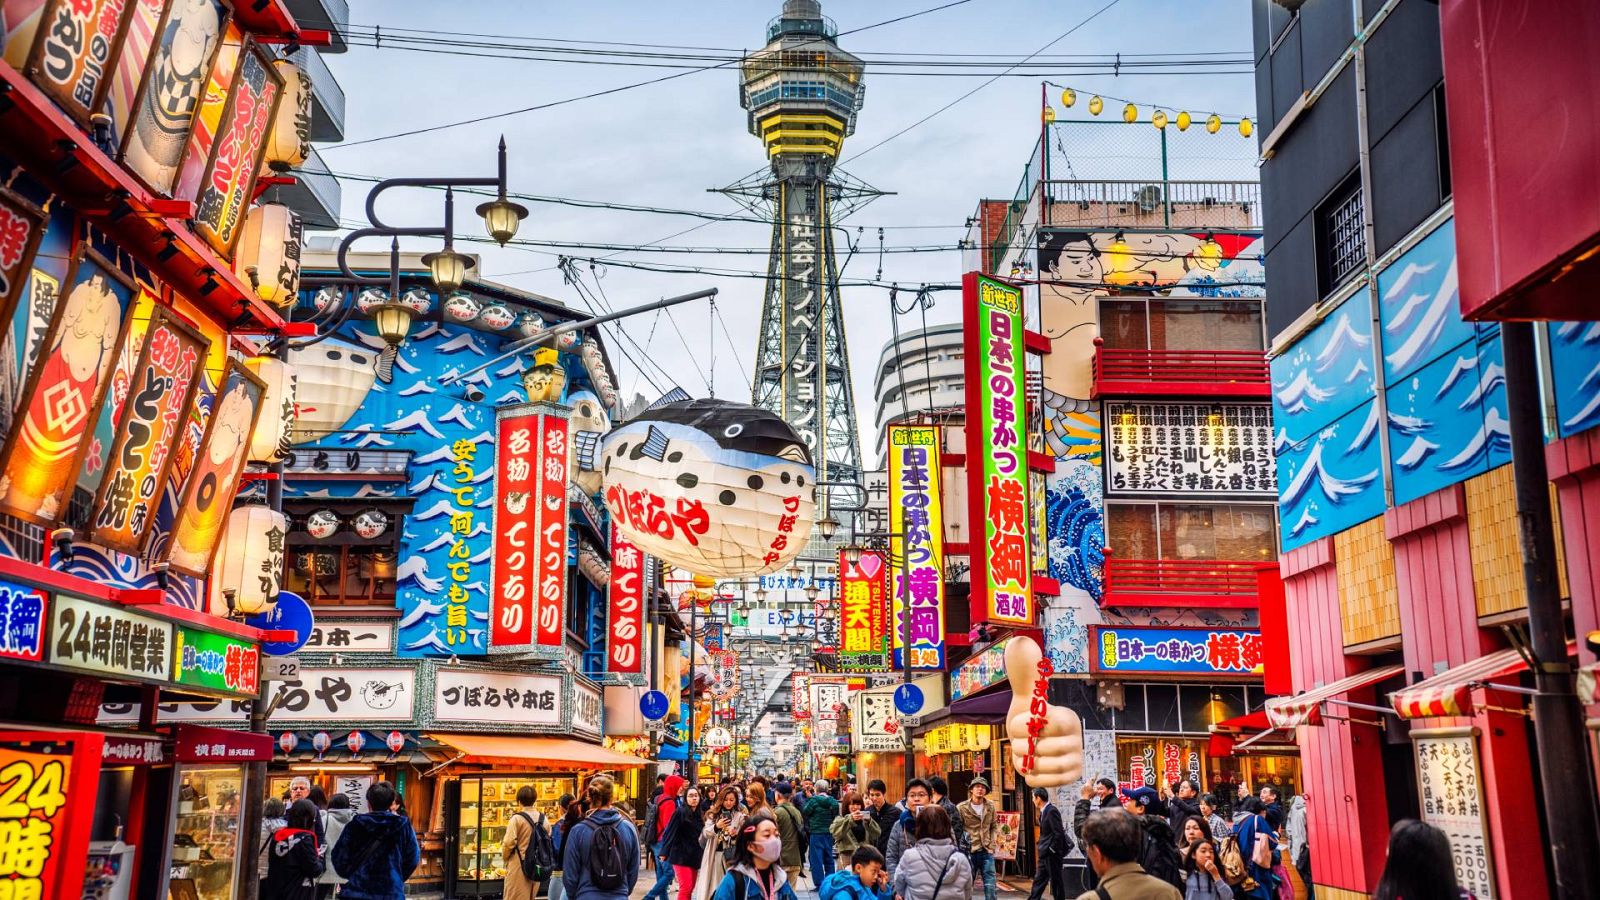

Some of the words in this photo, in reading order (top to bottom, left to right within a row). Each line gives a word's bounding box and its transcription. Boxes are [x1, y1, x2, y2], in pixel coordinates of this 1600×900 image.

[980, 283, 1019, 314] 新世界
[988, 310, 1017, 475] 日本一の串かつ
[131, 345, 198, 536] 大阪下町の味
[507, 430, 530, 482] 名物
[545, 430, 564, 482] 名物
[893, 429, 935, 446] 新世界
[446, 439, 478, 645] 安うて何んでも旨い
[606, 483, 710, 546] づぼらや
[763, 494, 801, 566] づぼらや
[987, 476, 1027, 590] 横綱
[501, 521, 531, 634] てっちり
[541, 522, 563, 634] てっちり
[994, 592, 1026, 617] 酒処
[57, 607, 165, 675] 24時間営業
[844, 580, 871, 652] 通天閣
[871, 580, 882, 652] TSUTENKAKU
[183, 645, 225, 675] 日本一の串かつ
[225, 645, 258, 691] 横綱
[1118, 639, 1206, 662] 日本一の串かつ
[442, 684, 556, 711] づぼらや本店
[195, 743, 226, 757] 横綱
[1144, 748, 1155, 785] ソースの
